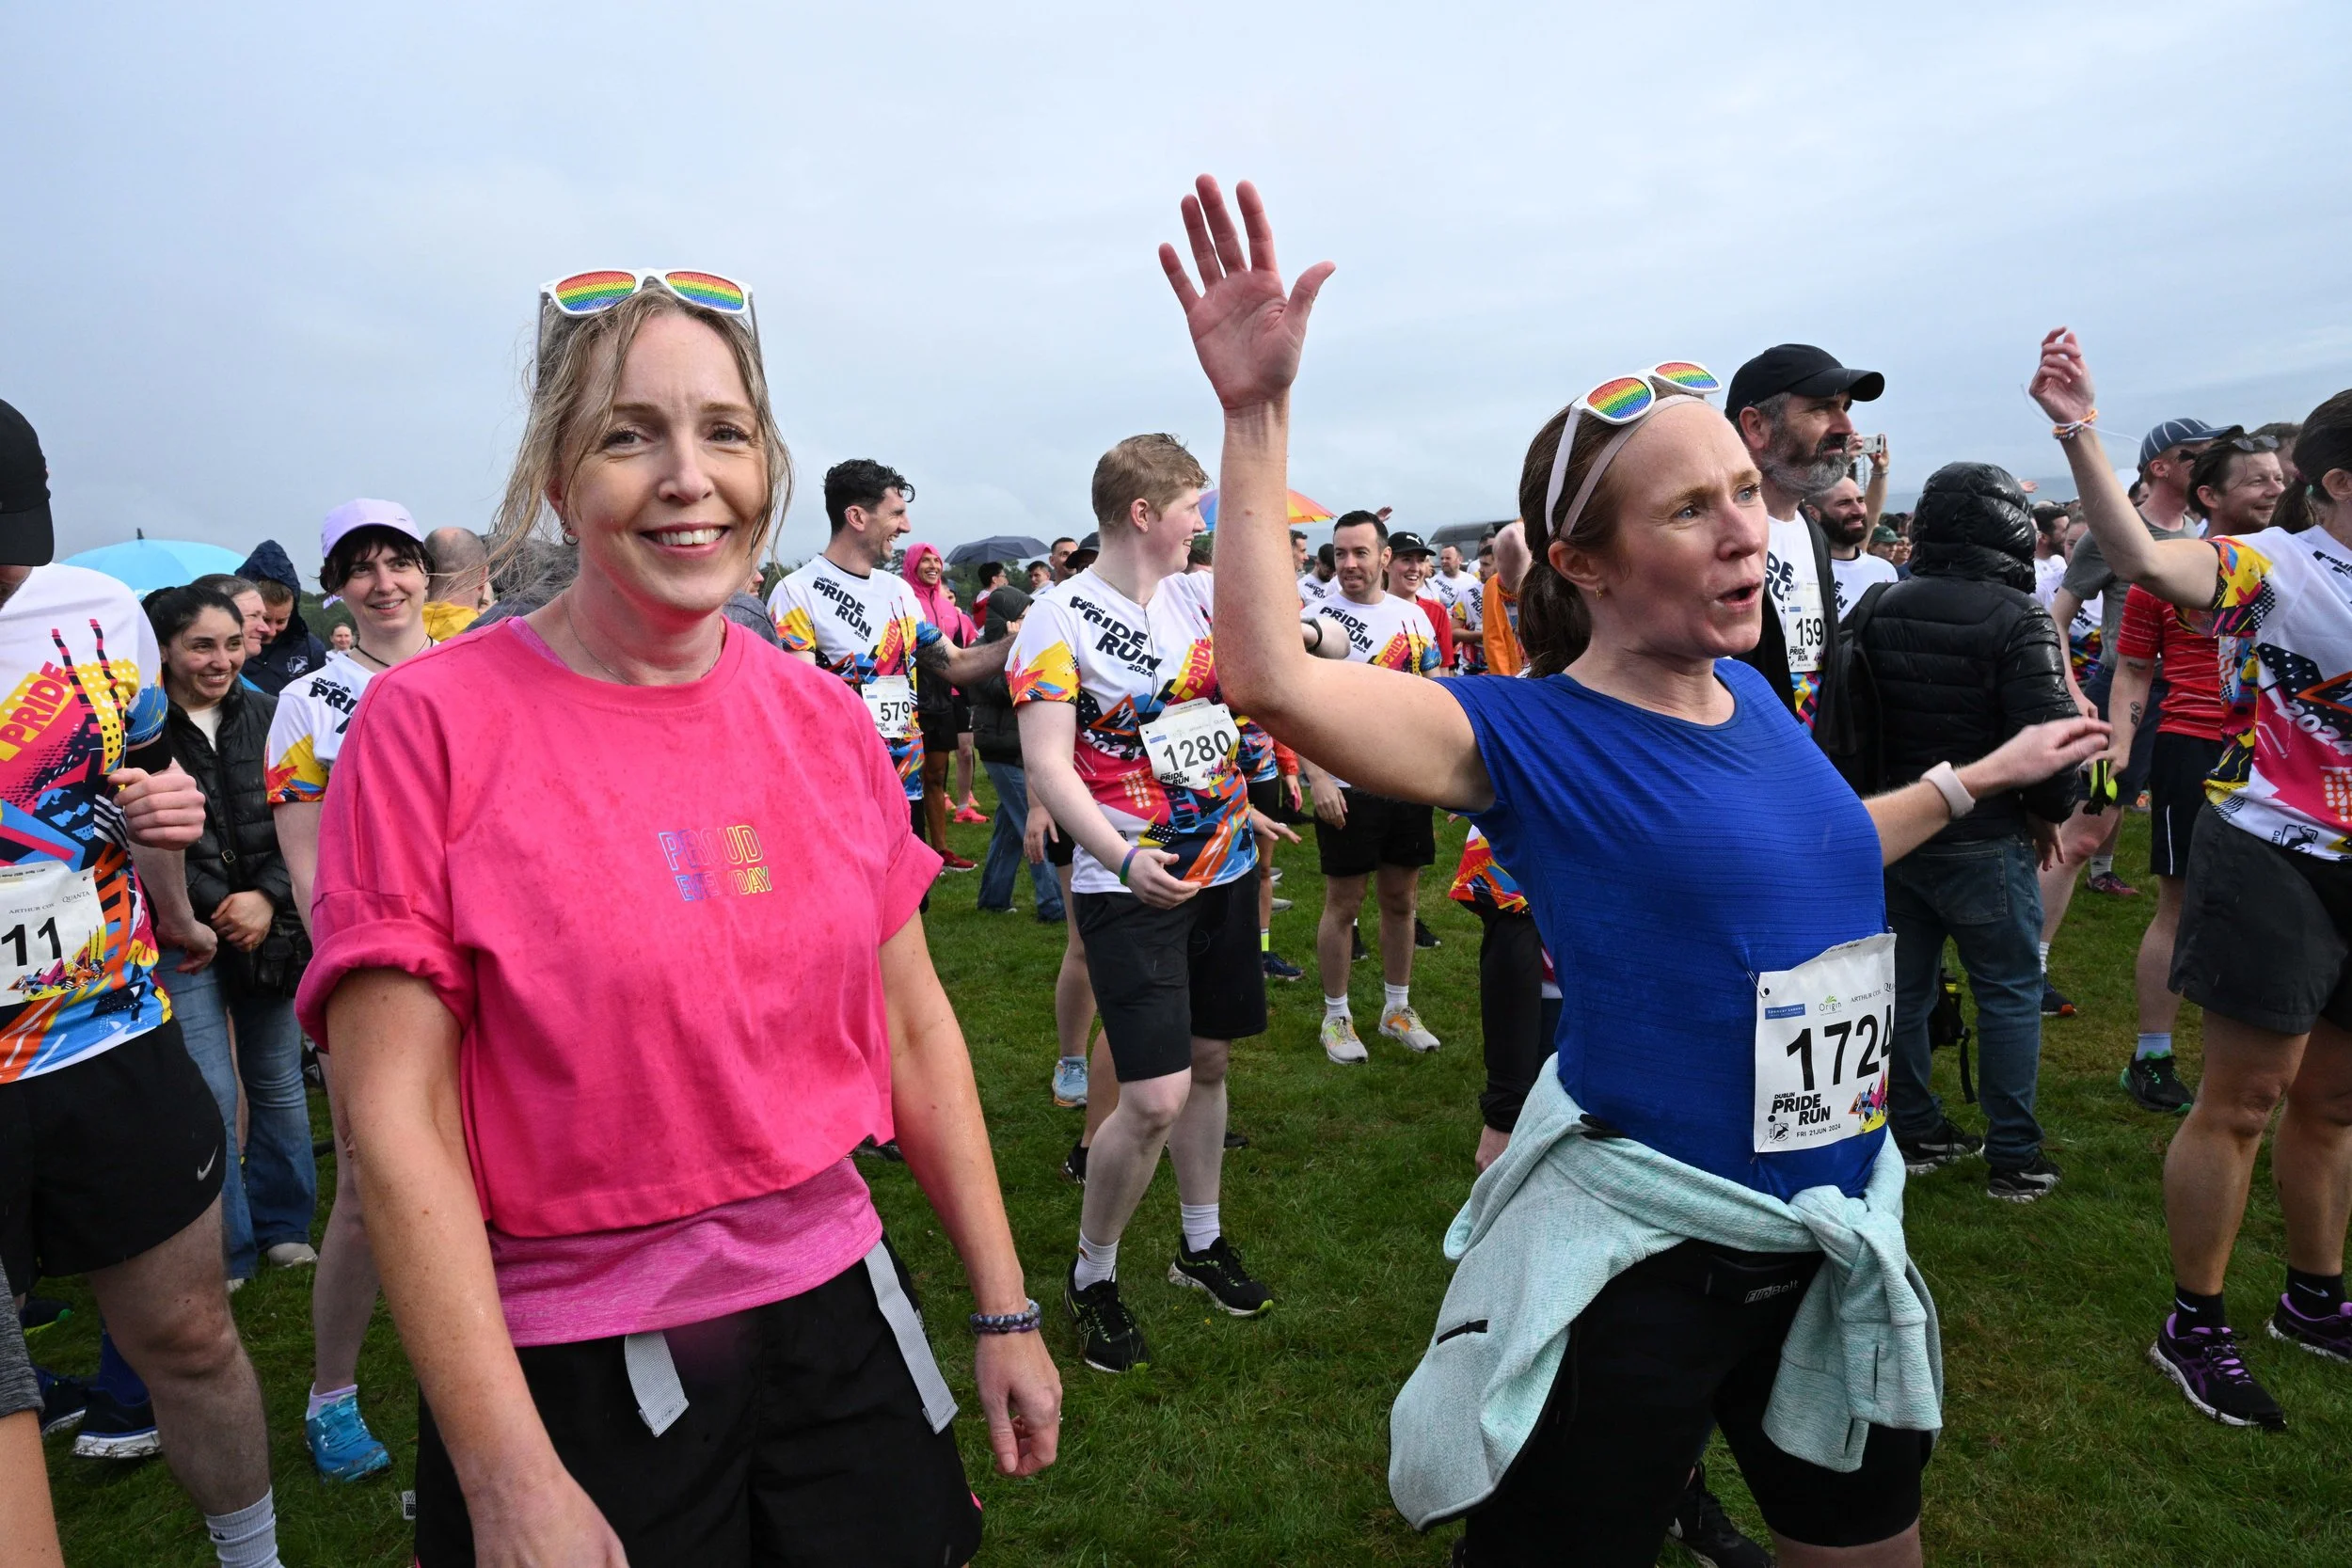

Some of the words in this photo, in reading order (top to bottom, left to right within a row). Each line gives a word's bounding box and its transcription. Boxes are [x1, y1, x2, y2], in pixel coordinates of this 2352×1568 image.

[817, 577, 840, 588] DUBLIN
[812, 579, 866, 617] PRIDE
[834, 604, 872, 638] RUN
[1070, 595, 1149, 650] PRIDE
[1319, 607, 1368, 634] PRIDE
[882, 617, 900, 657] PRIDE
[1095, 632, 1163, 671] RUN
[1383, 632, 1406, 664] PRIDE
[1127, 663, 1153, 677] 2024
[1184, 638, 1212, 691] PRIDE
[0, 660, 72, 751] PRIDE
[309, 681, 358, 715] PRI
[881, 701, 911, 721] 579
[1163, 729, 1232, 771] 1280
[1160, 771, 1184, 781] PRIDE
[1172, 776, 1190, 786] RUN
[659, 824, 764, 872] PROUD
[9, 905, 40, 915] ARTHUR
[62, 891, 90, 903] QUANTA
[1, 916, 62, 967] 11
[1819, 1002, 1842, 1012] Origin
[1851, 992, 1872, 1003] ARTHUR
[1787, 1004, 1894, 1091] 1724
[1772, 1093, 1821, 1115] PRIDE
[1798, 1105, 1831, 1126] RUN
[1828, 1123, 1841, 1132] 2024
